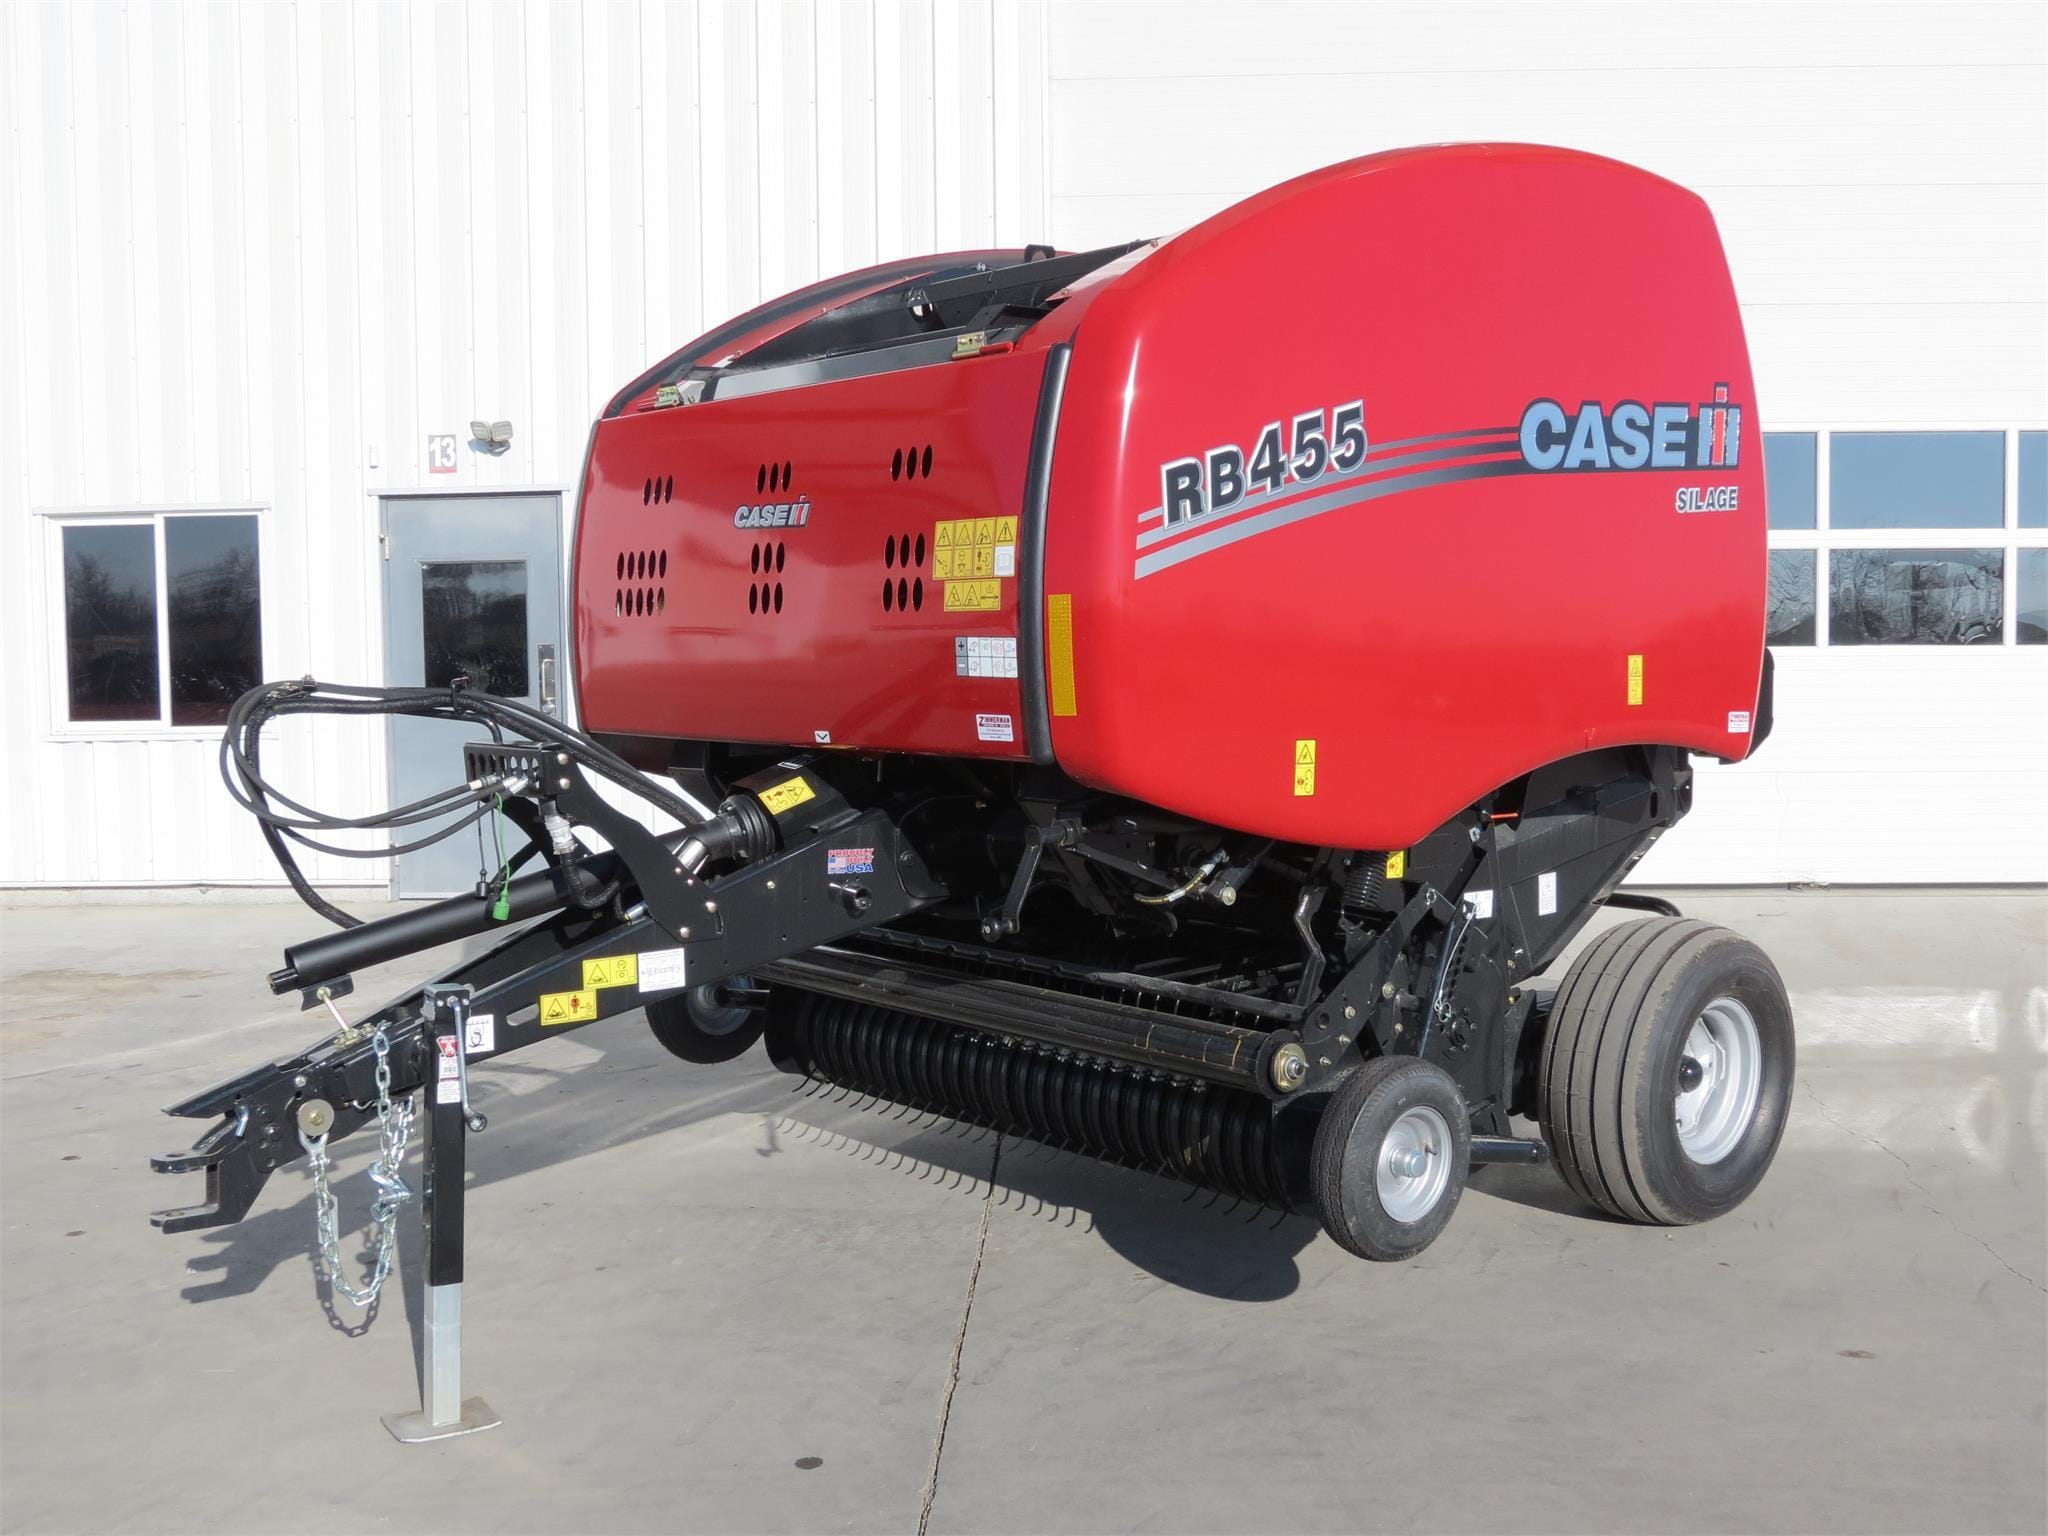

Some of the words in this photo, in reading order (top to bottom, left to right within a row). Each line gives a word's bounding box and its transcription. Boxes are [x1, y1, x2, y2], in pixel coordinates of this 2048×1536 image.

[429, 436, 456, 468] 13
[1161, 400, 1368, 530] RB455
[1676, 487, 1739, 514] SILAGE
[846, 863, 873, 873] USA
